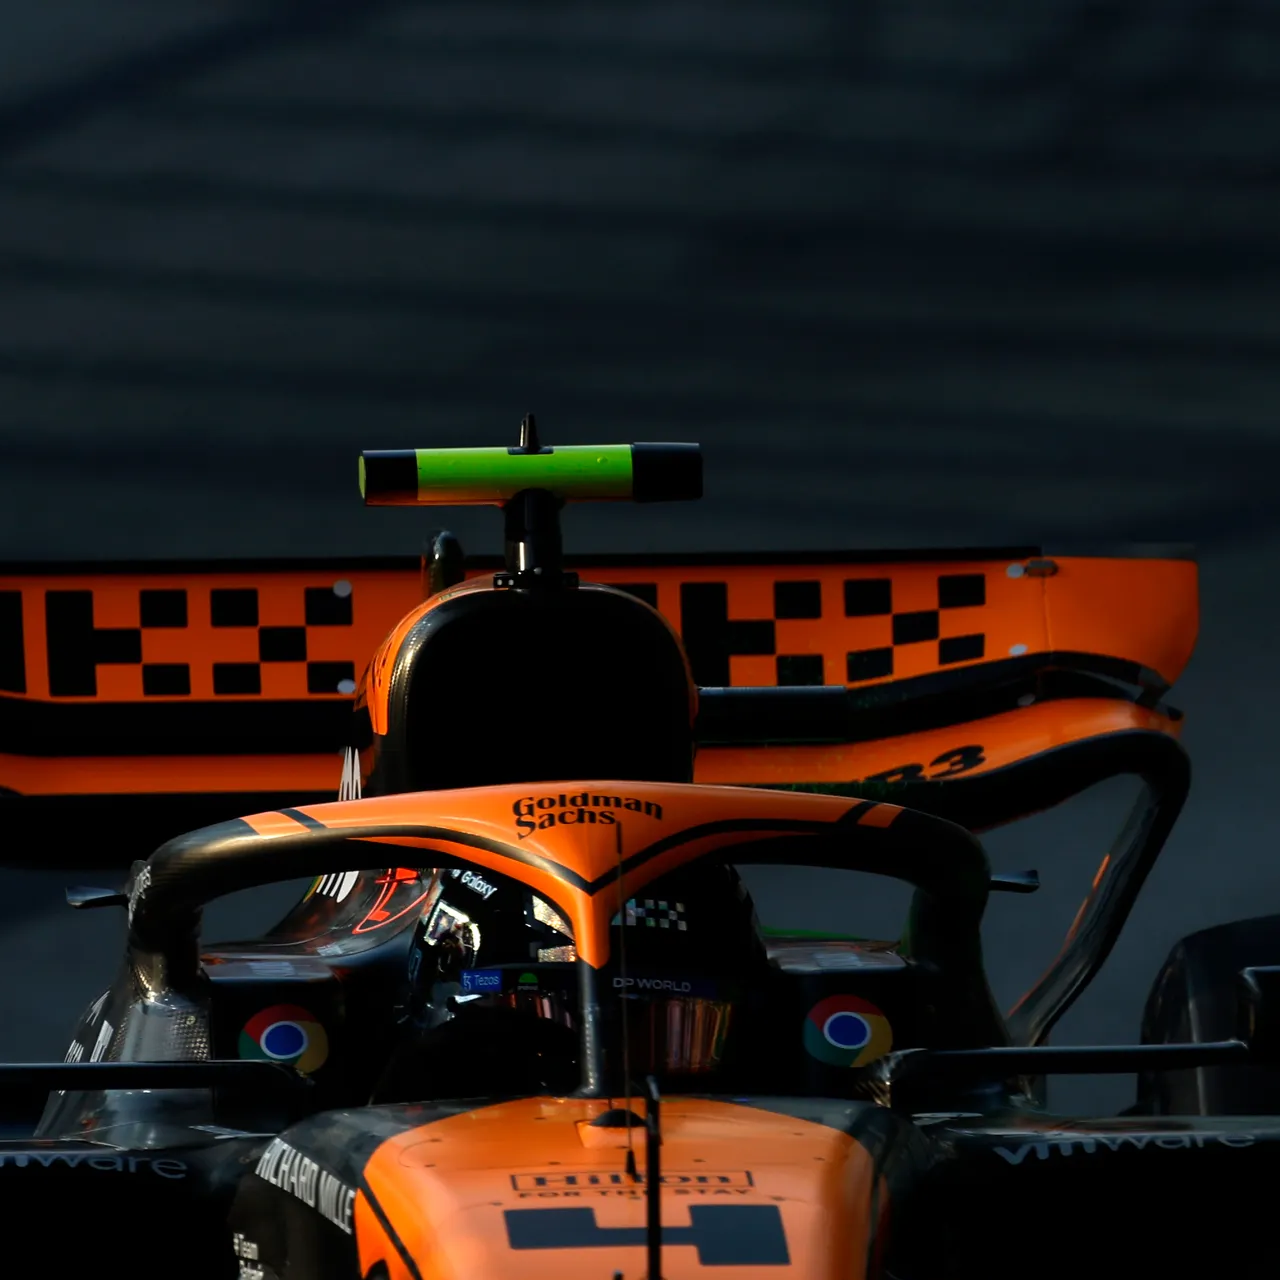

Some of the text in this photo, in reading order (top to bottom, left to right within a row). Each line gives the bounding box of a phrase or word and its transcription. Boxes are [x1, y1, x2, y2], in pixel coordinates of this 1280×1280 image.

[512, 793, 663, 820] Goldman
[515, 808, 616, 840] Sachs
[461, 870, 497, 900] Galaxy
[473, 974, 500, 986] Tezos
[612, 977, 692, 993] DP WORLD
[254, 1136, 356, 1236] RICHARD MILLE
[504, 1205, 791, 1265] 4
